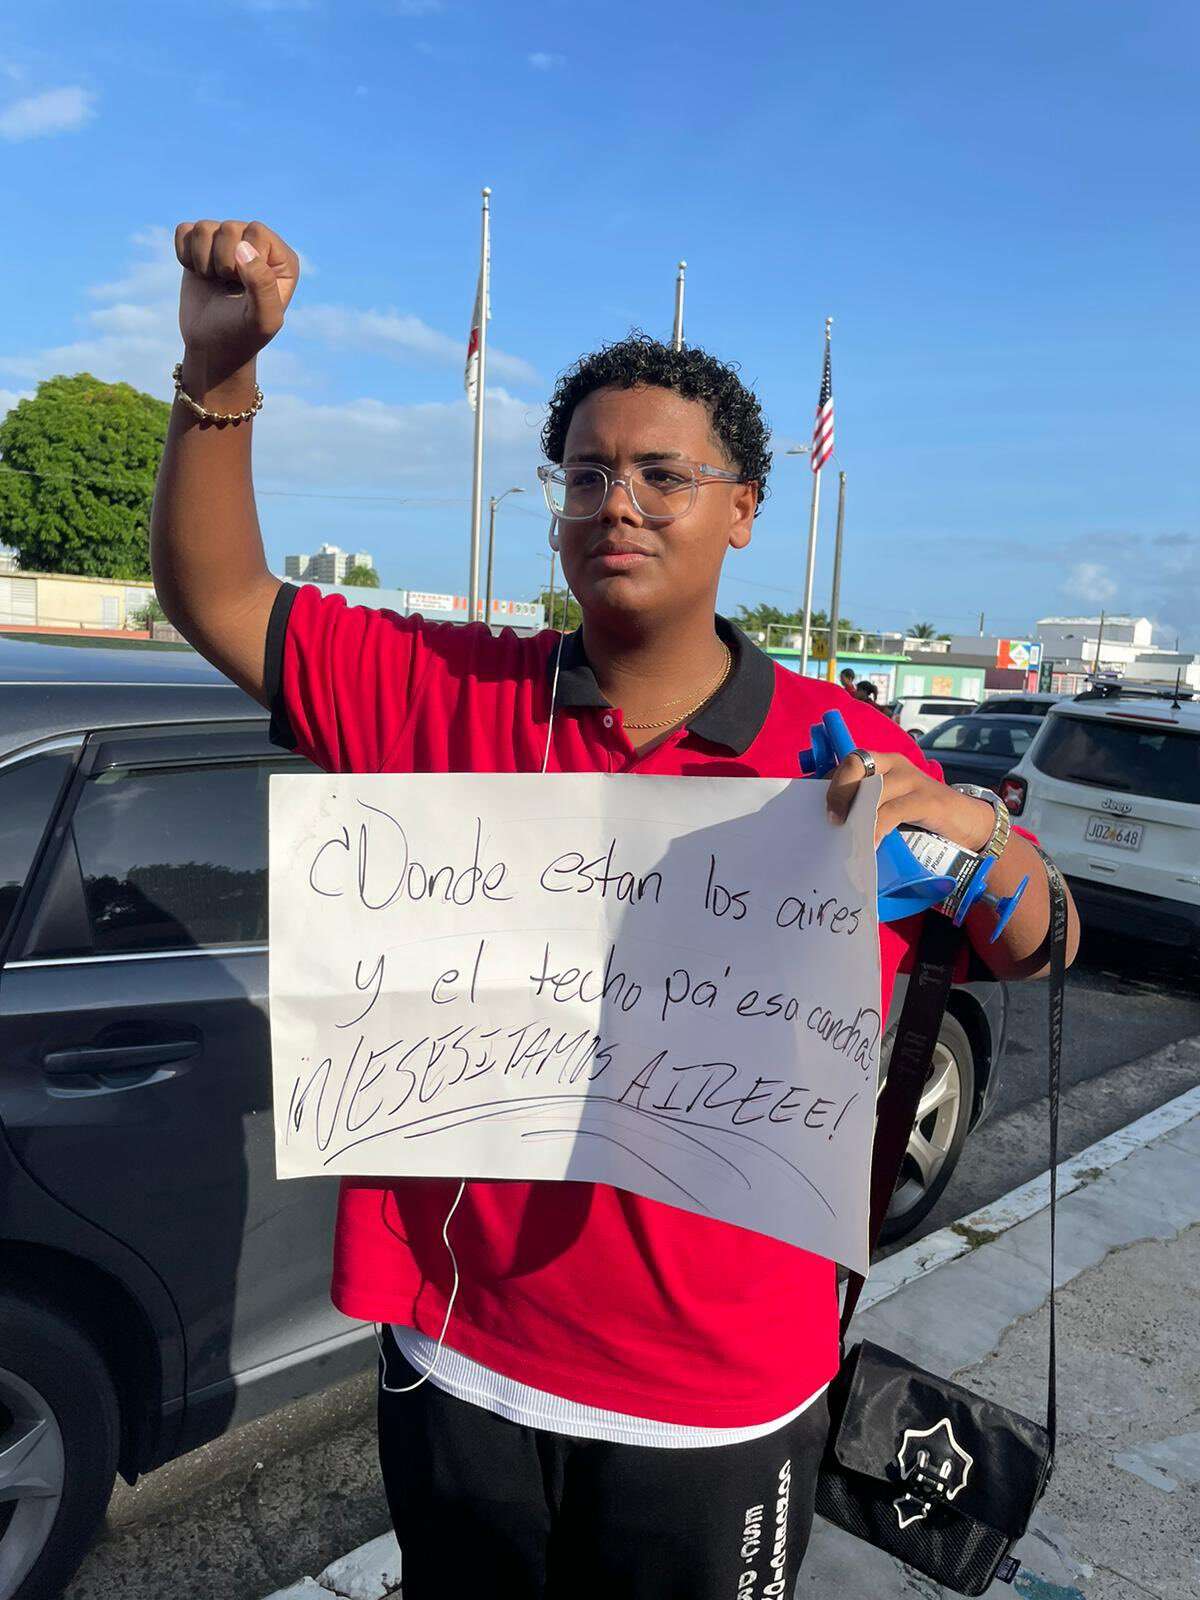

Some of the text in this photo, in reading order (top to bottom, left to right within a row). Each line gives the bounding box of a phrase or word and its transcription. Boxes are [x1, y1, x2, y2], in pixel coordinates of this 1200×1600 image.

[1101, 798, 1133, 814] Jeep
[1116, 828, 1139, 846] 648
[540, 838, 662, 904] estan
[704, 854, 751, 920] los
[776, 889, 862, 935] aires
[335, 953, 385, 1029] y
[431, 939, 485, 1004] el
[529, 943, 642, 1012] techo
[736, 990, 800, 1021] esa
